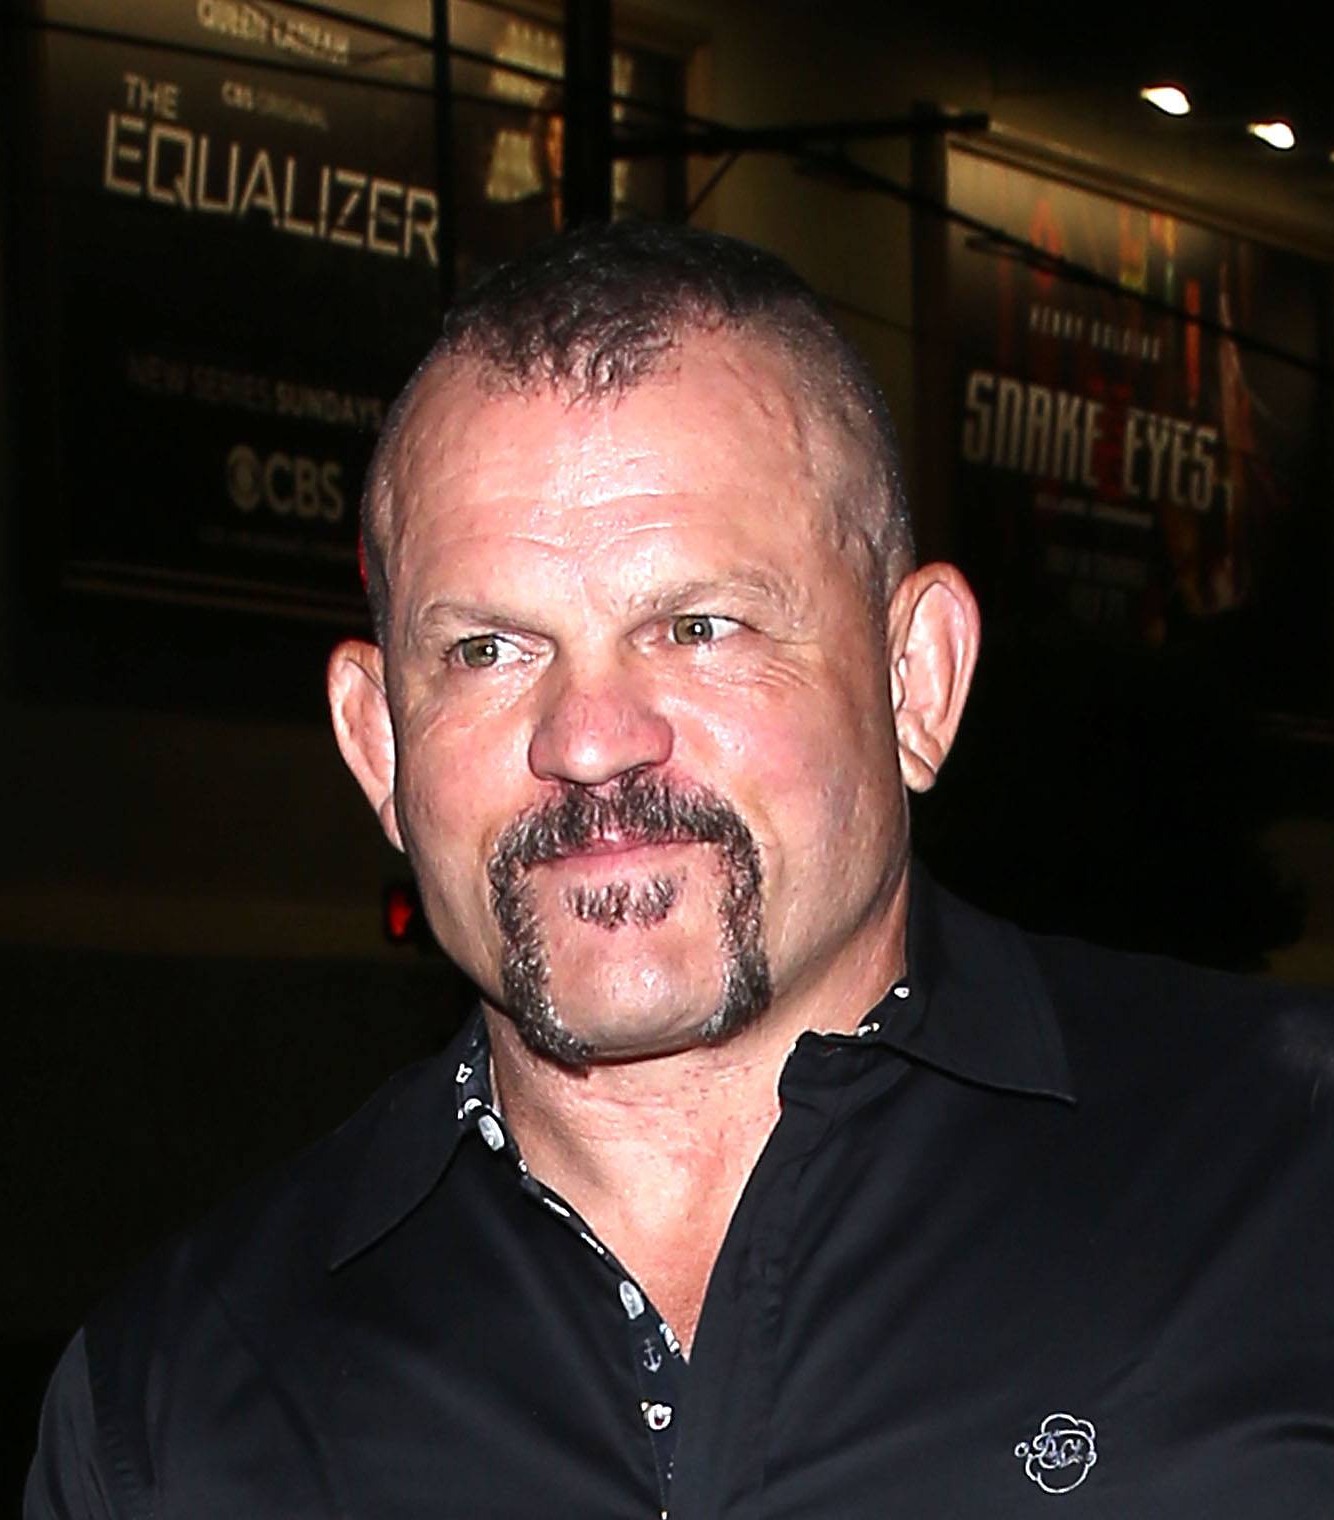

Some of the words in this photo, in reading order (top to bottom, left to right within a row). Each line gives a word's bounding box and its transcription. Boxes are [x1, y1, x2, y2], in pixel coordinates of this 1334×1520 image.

[124, 73, 181, 121] THE
[103, 111, 441, 268] EQUALIZER
[266, 451, 345, 524] CBS
[963, 368, 1104, 490] SNAKE
[1122, 407, 1220, 512] EYES
